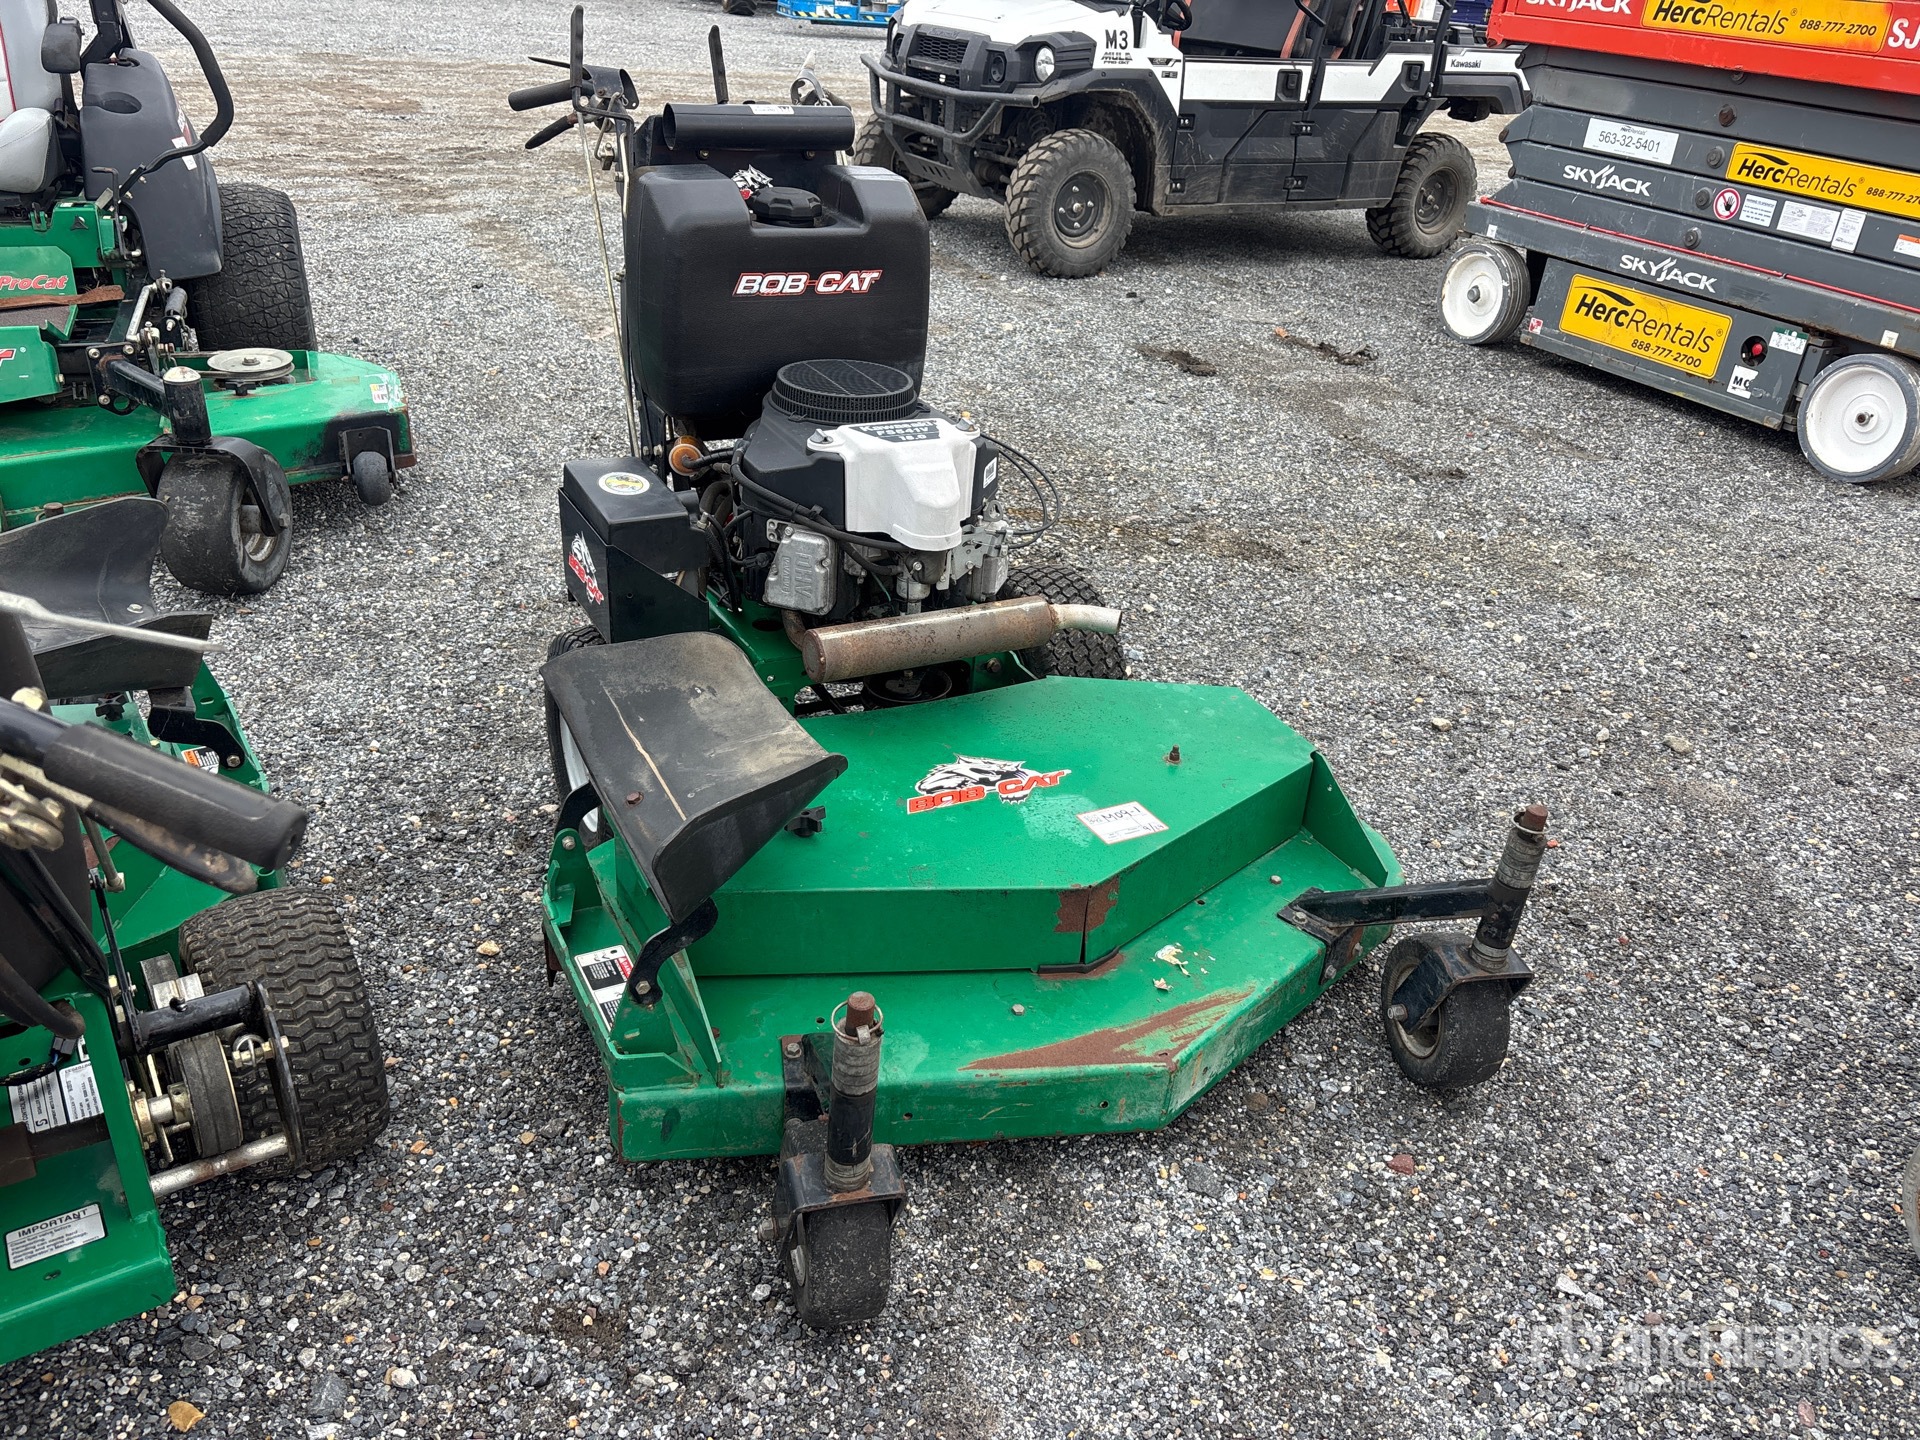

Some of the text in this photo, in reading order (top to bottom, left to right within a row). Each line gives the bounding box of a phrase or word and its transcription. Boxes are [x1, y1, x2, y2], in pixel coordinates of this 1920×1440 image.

[1652, 1, 1789, 35] HercRentals
[1799, 19, 1877, 36] 888-777-2700
[1105, 29, 1128, 50] M3
[1100, 51, 1133, 61] MULE
[1450, 59, 1481, 69] Kawasaki
[1598, 130, 1661, 153] 563-32-5401
[1562, 164, 1651, 196] SKYJACK
[1737, 158, 1858, 198] HercRentals
[0, 274, 68, 290] ProCat
[734, 271, 882, 297] BOB-CAT
[1619, 254, 1717, 293] SKYJACK
[1575, 293, 1714, 353] HercRentals
[1631, 339, 1702, 368] 888-777-2700
[858, 419, 934, 432] Kawasaki
[18, 1208, 88, 1238] IMPORTANT
